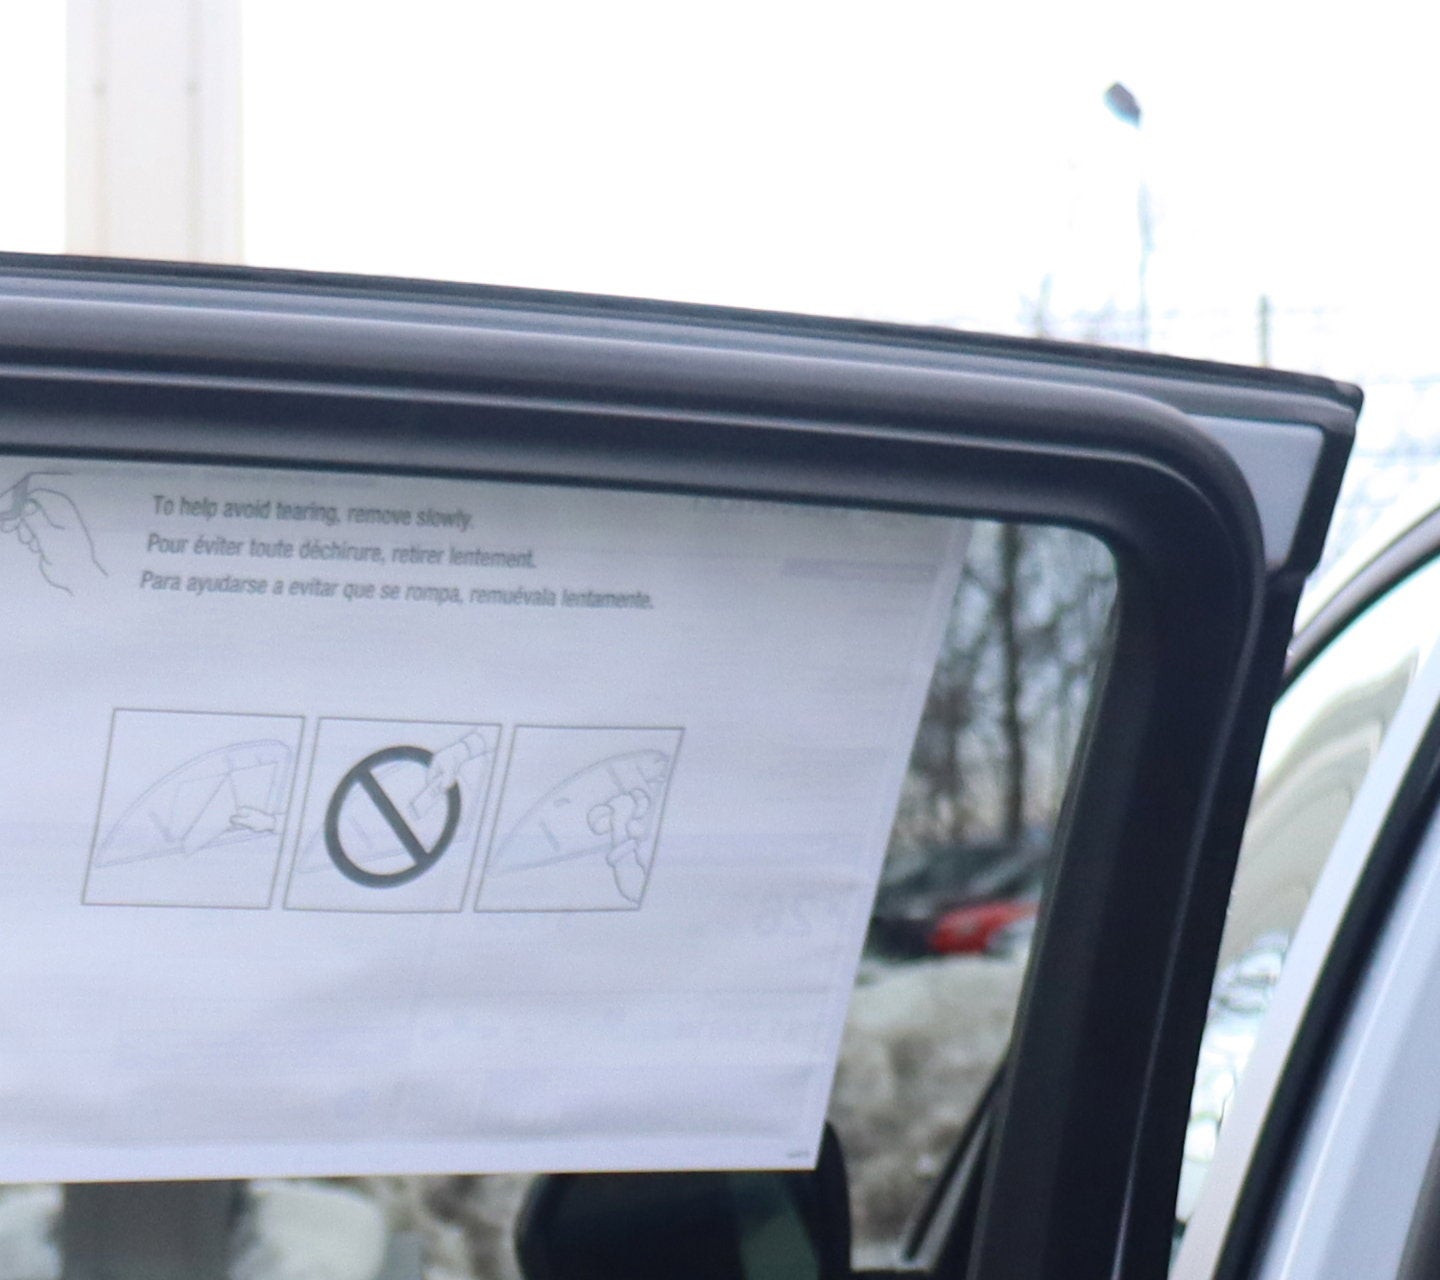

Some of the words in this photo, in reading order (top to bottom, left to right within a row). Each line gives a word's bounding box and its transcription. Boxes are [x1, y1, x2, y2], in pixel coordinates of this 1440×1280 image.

[153, 495, 175, 517] To
[179, 496, 217, 522] help
[223, 500, 270, 519] avoid
[348, 507, 412, 526] remove
[147, 533, 188, 555] Pour
[193, 535, 244, 557] éviter
[250, 538, 294, 559] toute
[299, 538, 385, 565] déchirure,
[391, 546, 444, 565] retirer
[139, 570, 181, 591] Para
[186, 573, 268, 596] ayudarse
[273, 580, 284, 595] a
[289, 577, 339, 597] evitar
[343, 583, 375, 602] que
[380, 583, 401, 600] se
[405, 585, 463, 606] rompa,
